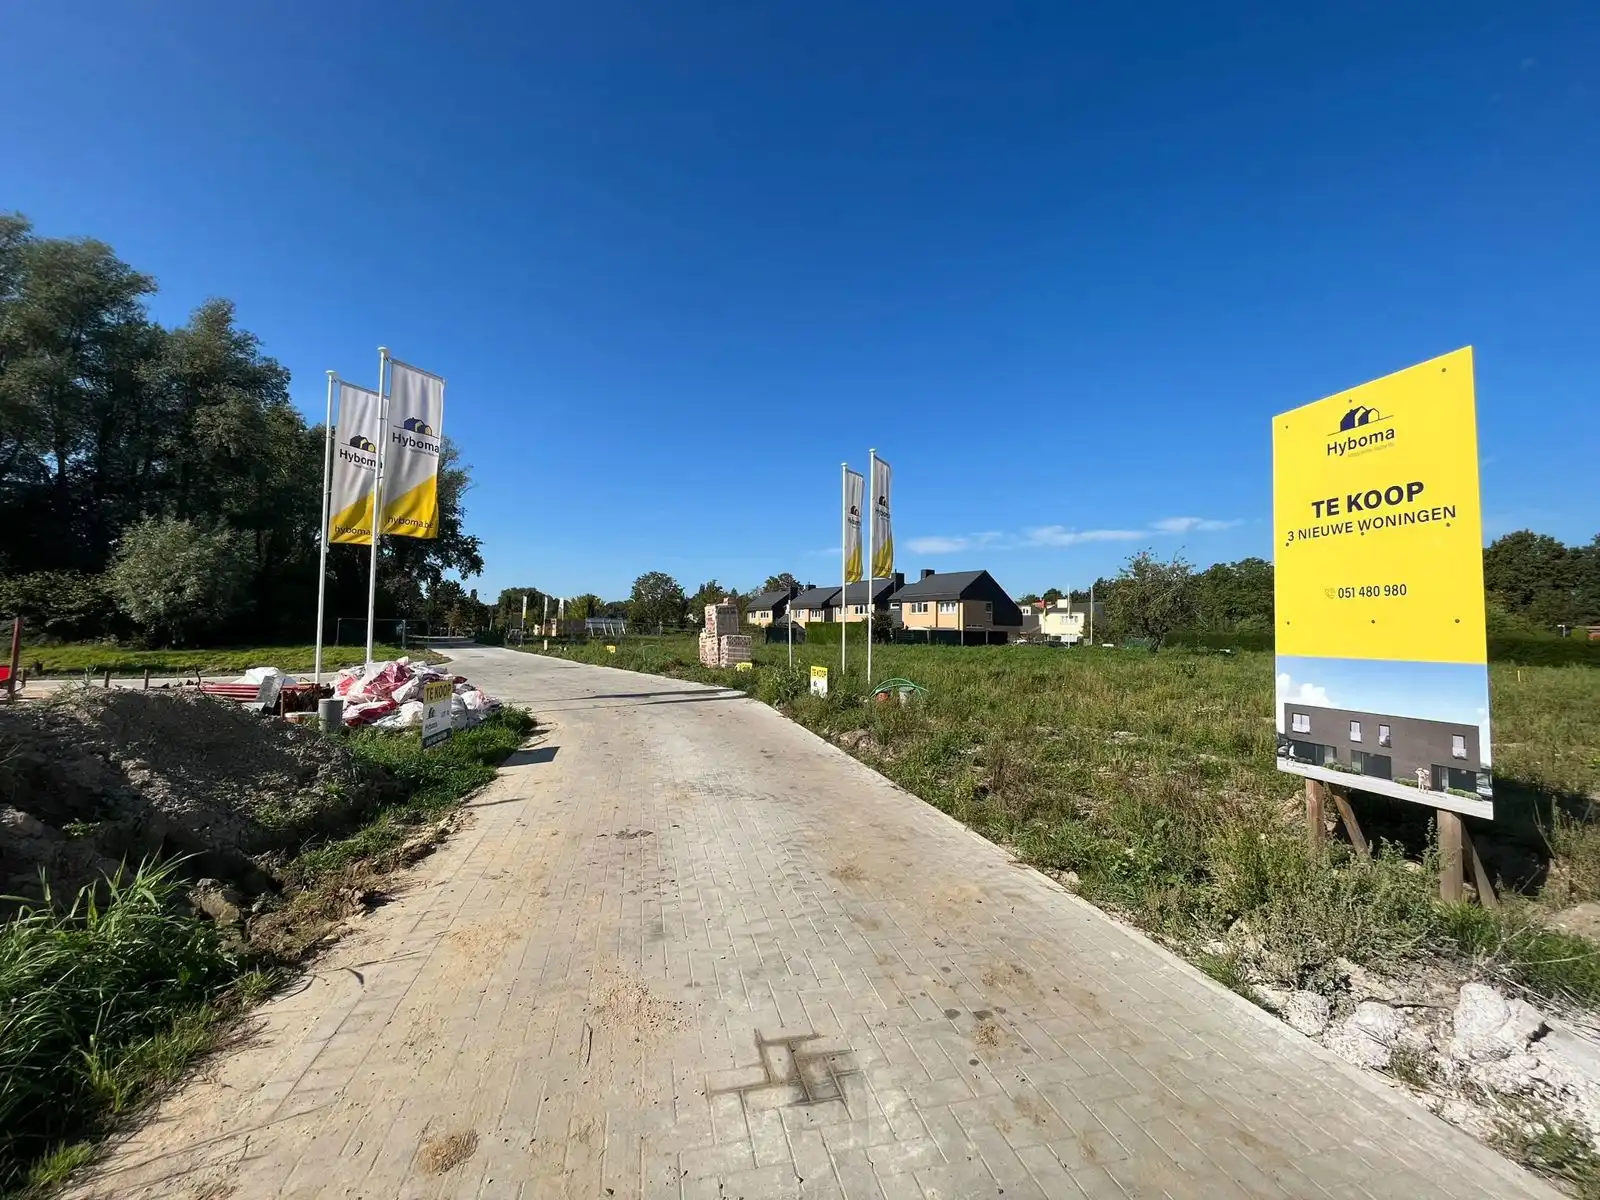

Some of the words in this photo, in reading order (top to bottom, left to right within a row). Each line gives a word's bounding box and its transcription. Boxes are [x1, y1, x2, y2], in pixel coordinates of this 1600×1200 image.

[392, 432, 440, 453] Hyboma
[1327, 428, 1395, 456] Hyboma
[1311, 498, 1340, 518] TE
[1347, 481, 1424, 513] KOOP
[1287, 531, 1295, 541] 3
[1298, 521, 1353, 540] NIEUWE
[1358, 505, 1456, 531] WONINGEN
[1338, 587, 1356, 599] 051
[1358, 585, 1380, 598] 480
[1384, 583, 1407, 597] 980
[426, 688, 433, 701] TE
[434, 683, 451, 699] KOOP
